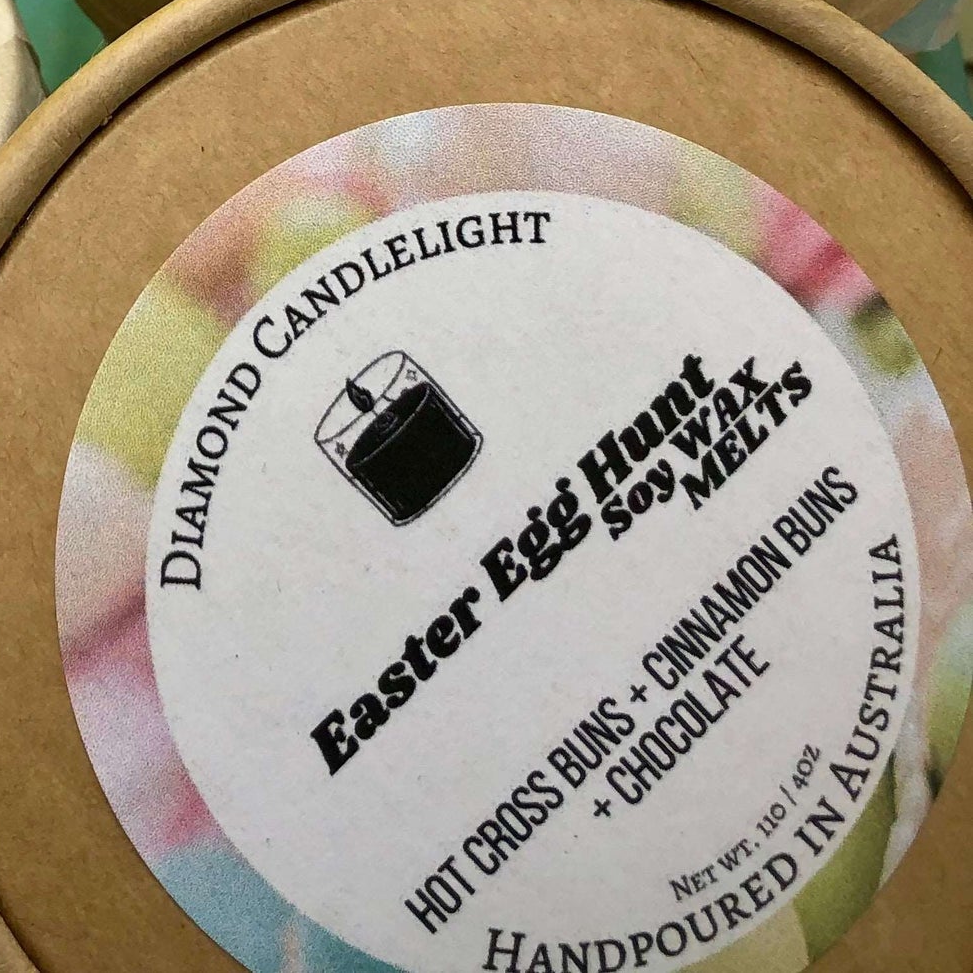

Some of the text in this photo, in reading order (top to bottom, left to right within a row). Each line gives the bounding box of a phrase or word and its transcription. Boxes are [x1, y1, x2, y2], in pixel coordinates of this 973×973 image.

[601, 356, 768, 541] Soy WAX
[680, 361, 812, 510] MELTS
[309, 354, 714, 775] Easter Egg Hunt
[404, 466, 858, 934] HOT CROSS BUNS + CINNAMON BUNS
[593, 634, 770, 819] + CHOCOLATE
[779, 784, 798, 807] /
